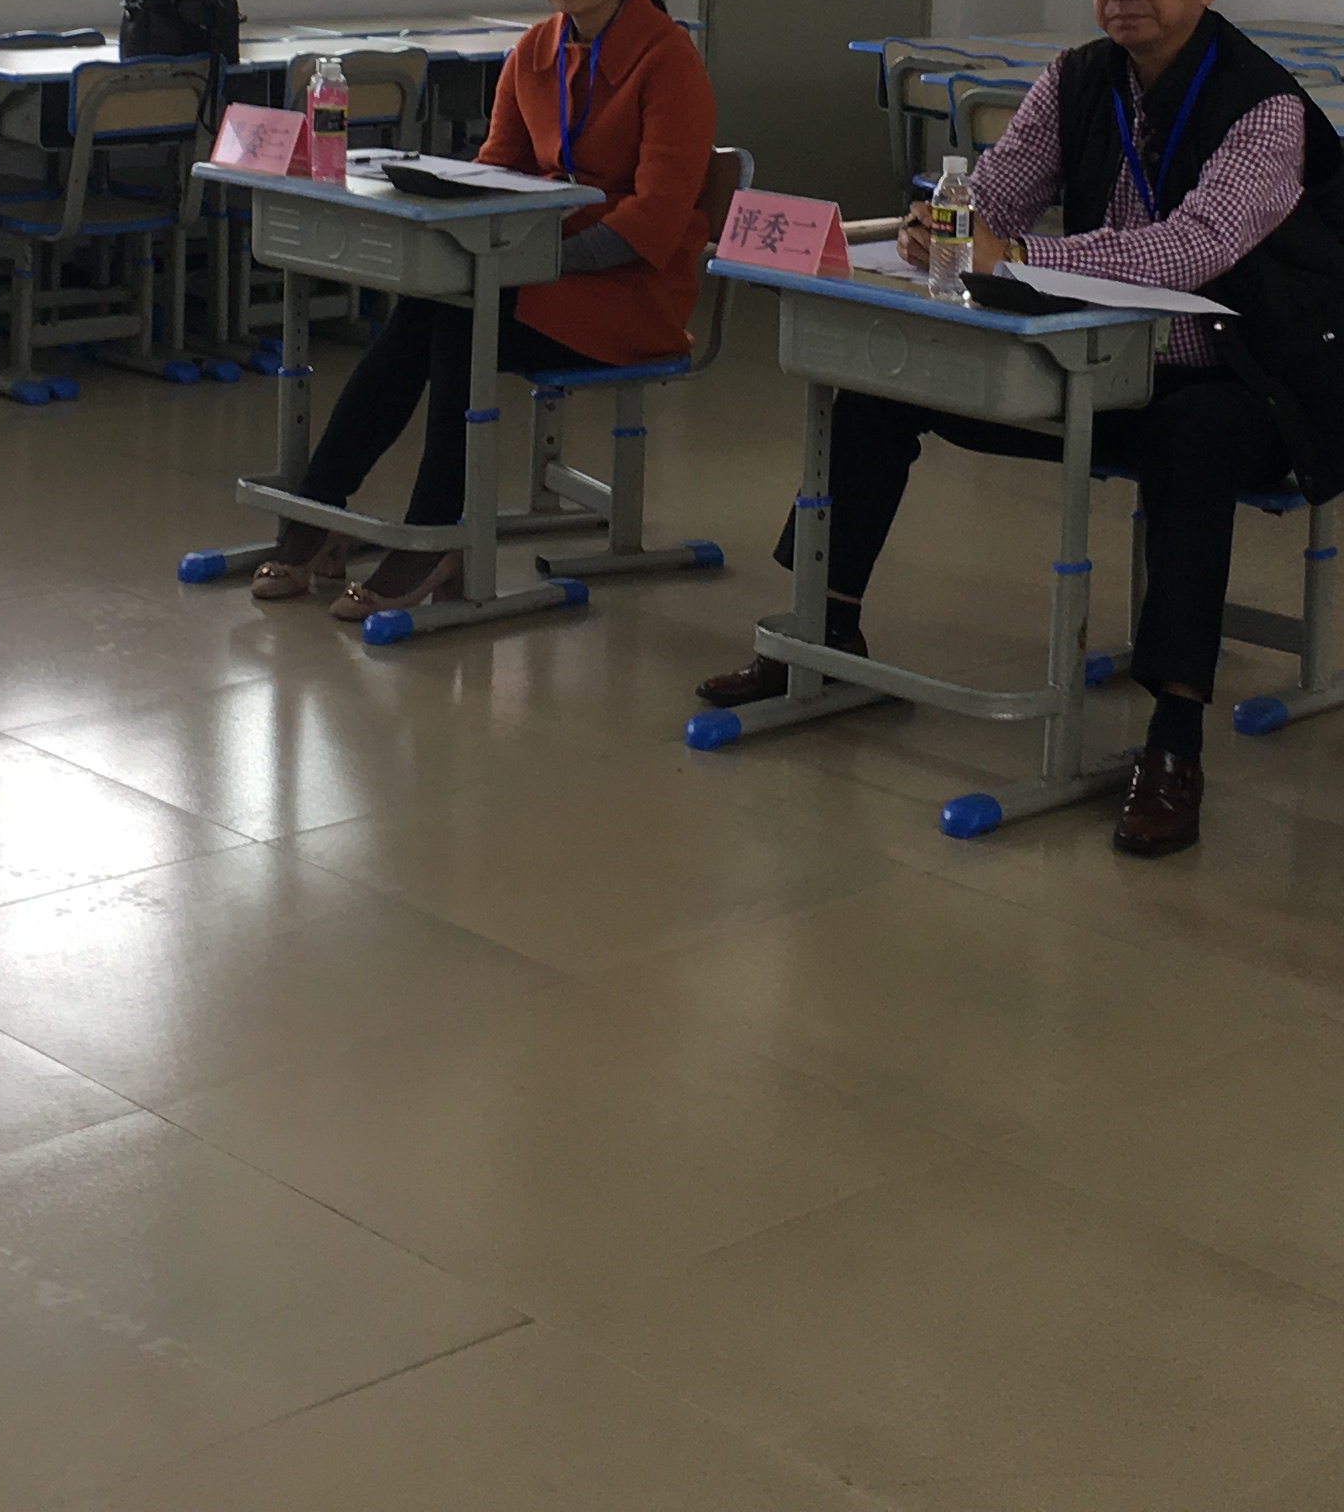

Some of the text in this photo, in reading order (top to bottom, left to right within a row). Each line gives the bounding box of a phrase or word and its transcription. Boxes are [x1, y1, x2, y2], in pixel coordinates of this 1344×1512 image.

[232, 120, 290, 160] 委三
[729, 205, 817, 255] 评委二
